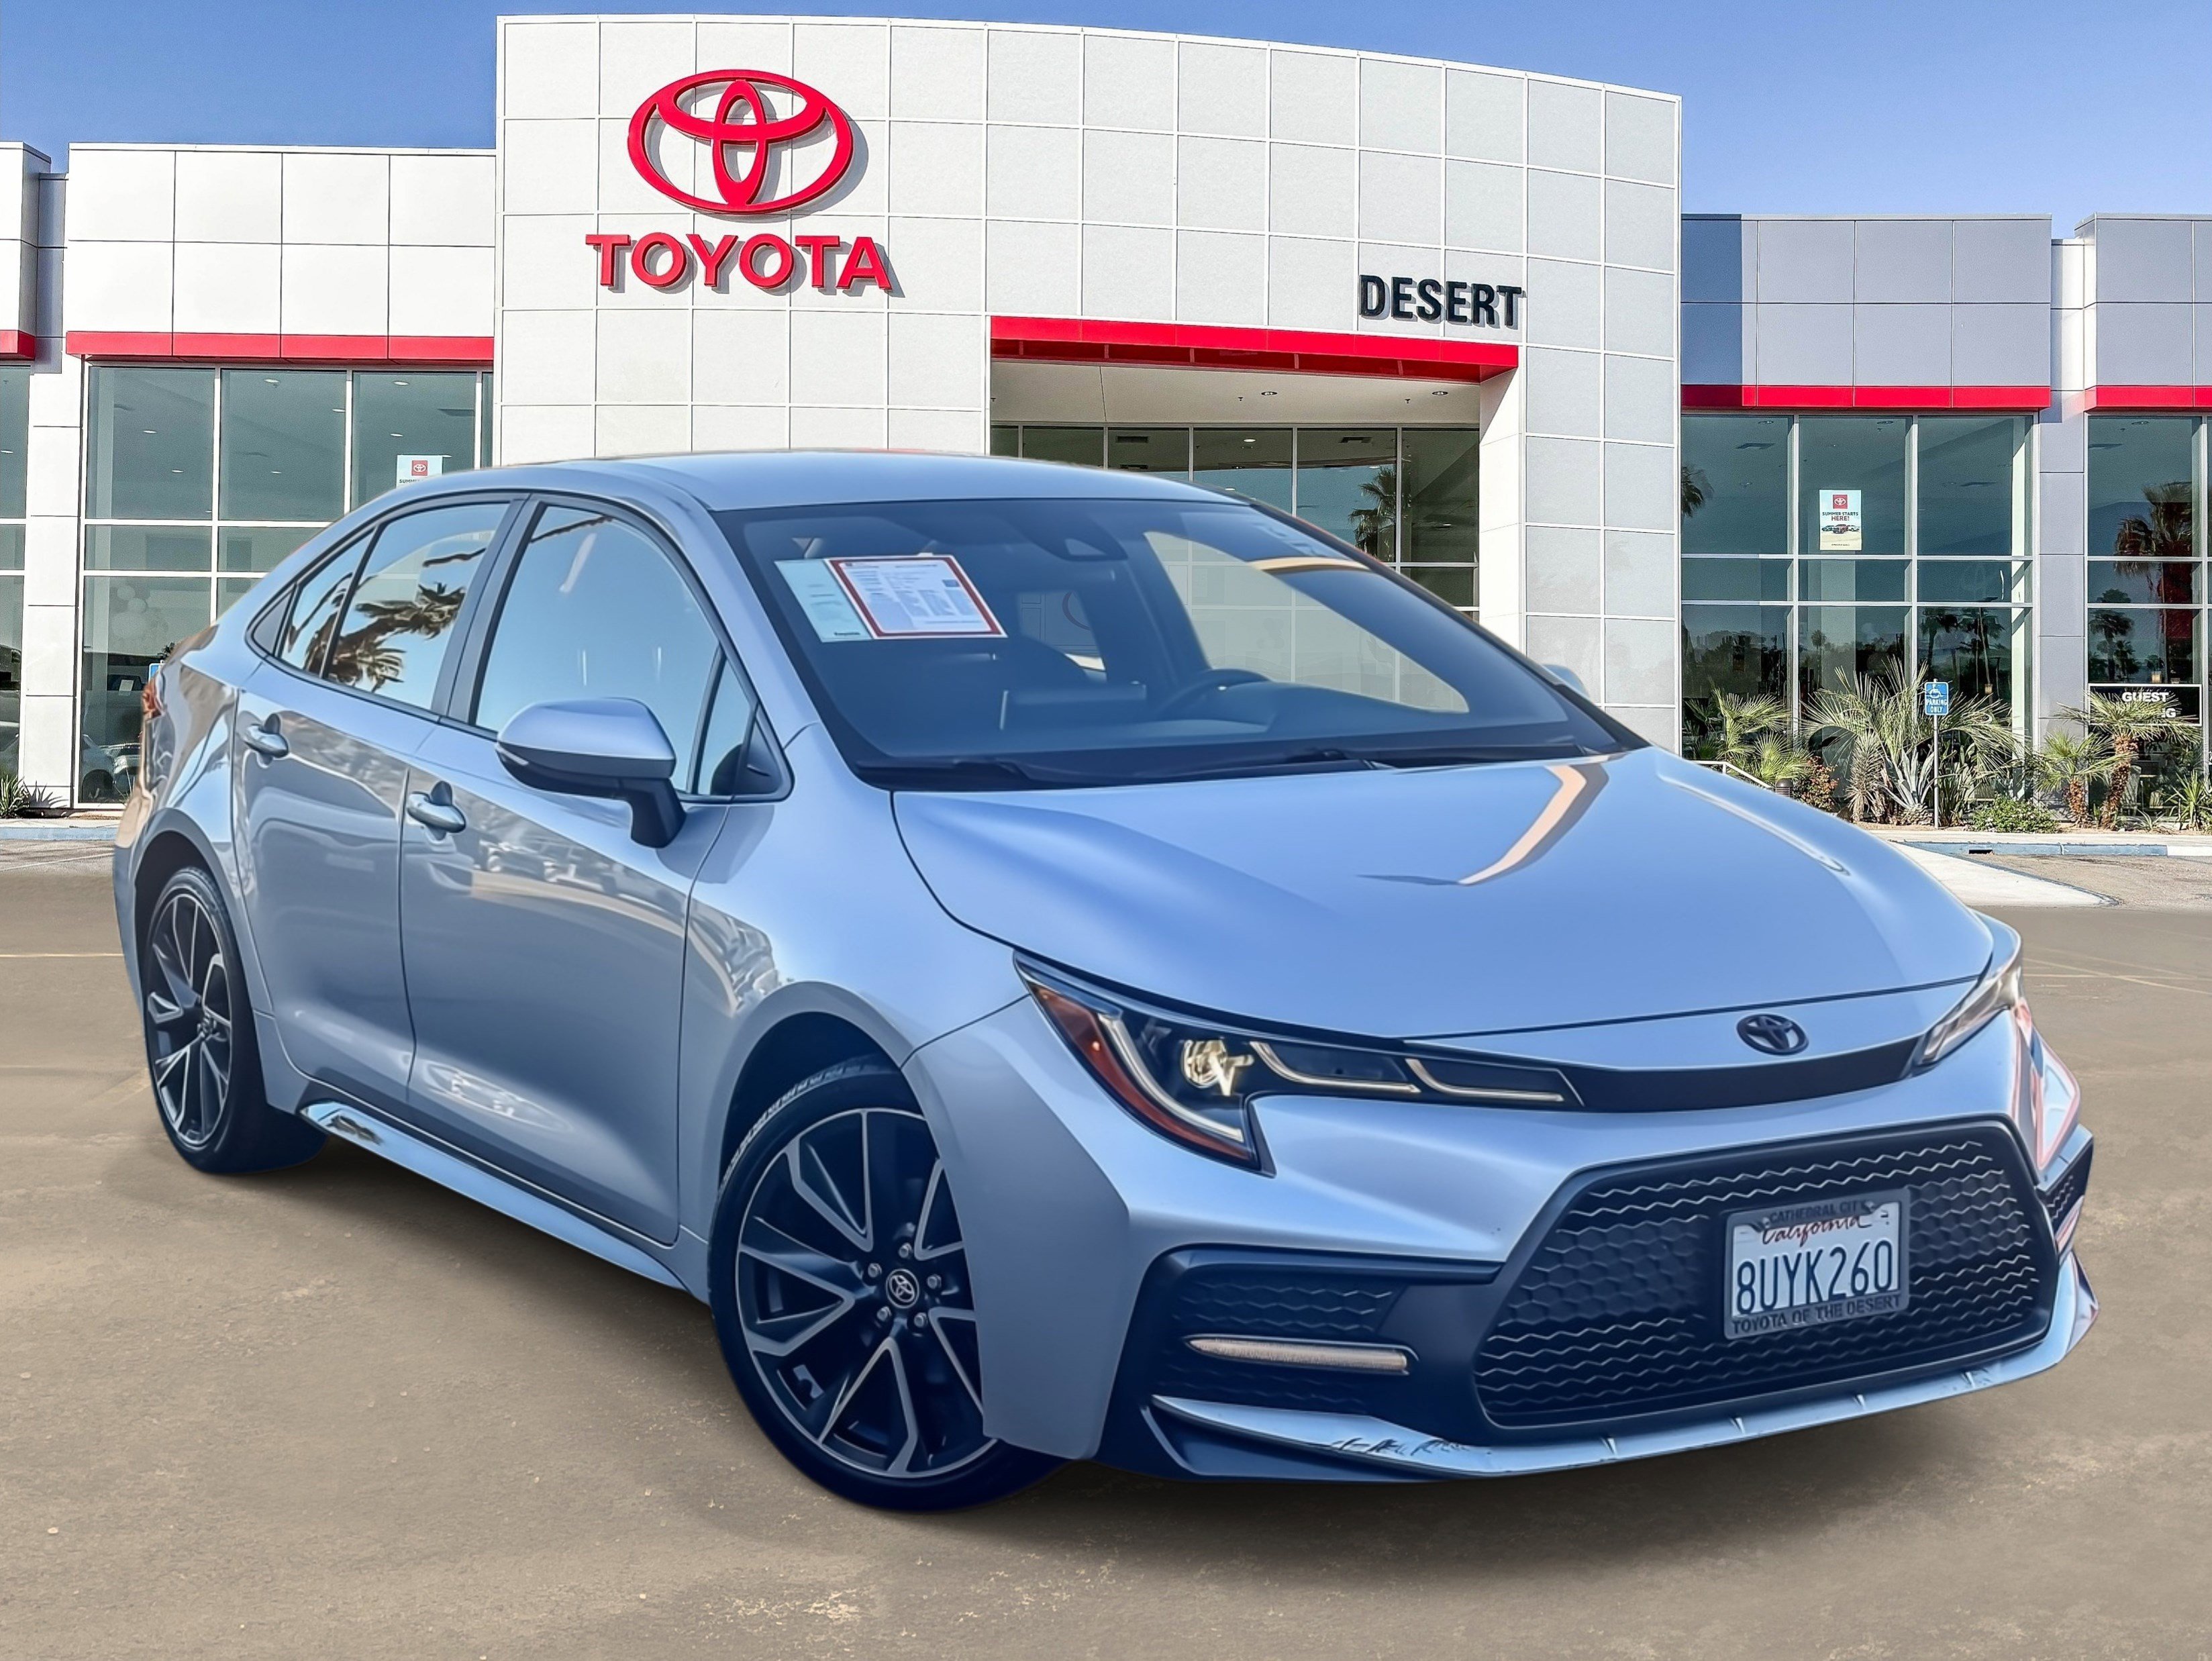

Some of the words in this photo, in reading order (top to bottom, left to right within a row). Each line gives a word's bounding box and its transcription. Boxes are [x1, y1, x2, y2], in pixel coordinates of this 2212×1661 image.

[585, 232, 893, 291] TOYOTA
[1359, 274, 1522, 326] DESERT
[2121, 692, 2170, 703] GUEST
[1762, 1215, 1872, 1247] California
[1770, 1203, 1836, 1223] CATHEDRAL
[1737, 1240, 1893, 1315] 8UYK260
[1732, 1313, 1787, 1334] TOYOTA
[1792, 1308, 1810, 1324] OF
[1815, 1303, 1843, 1319] THE
[1847, 1294, 1901, 1315] DESERT
